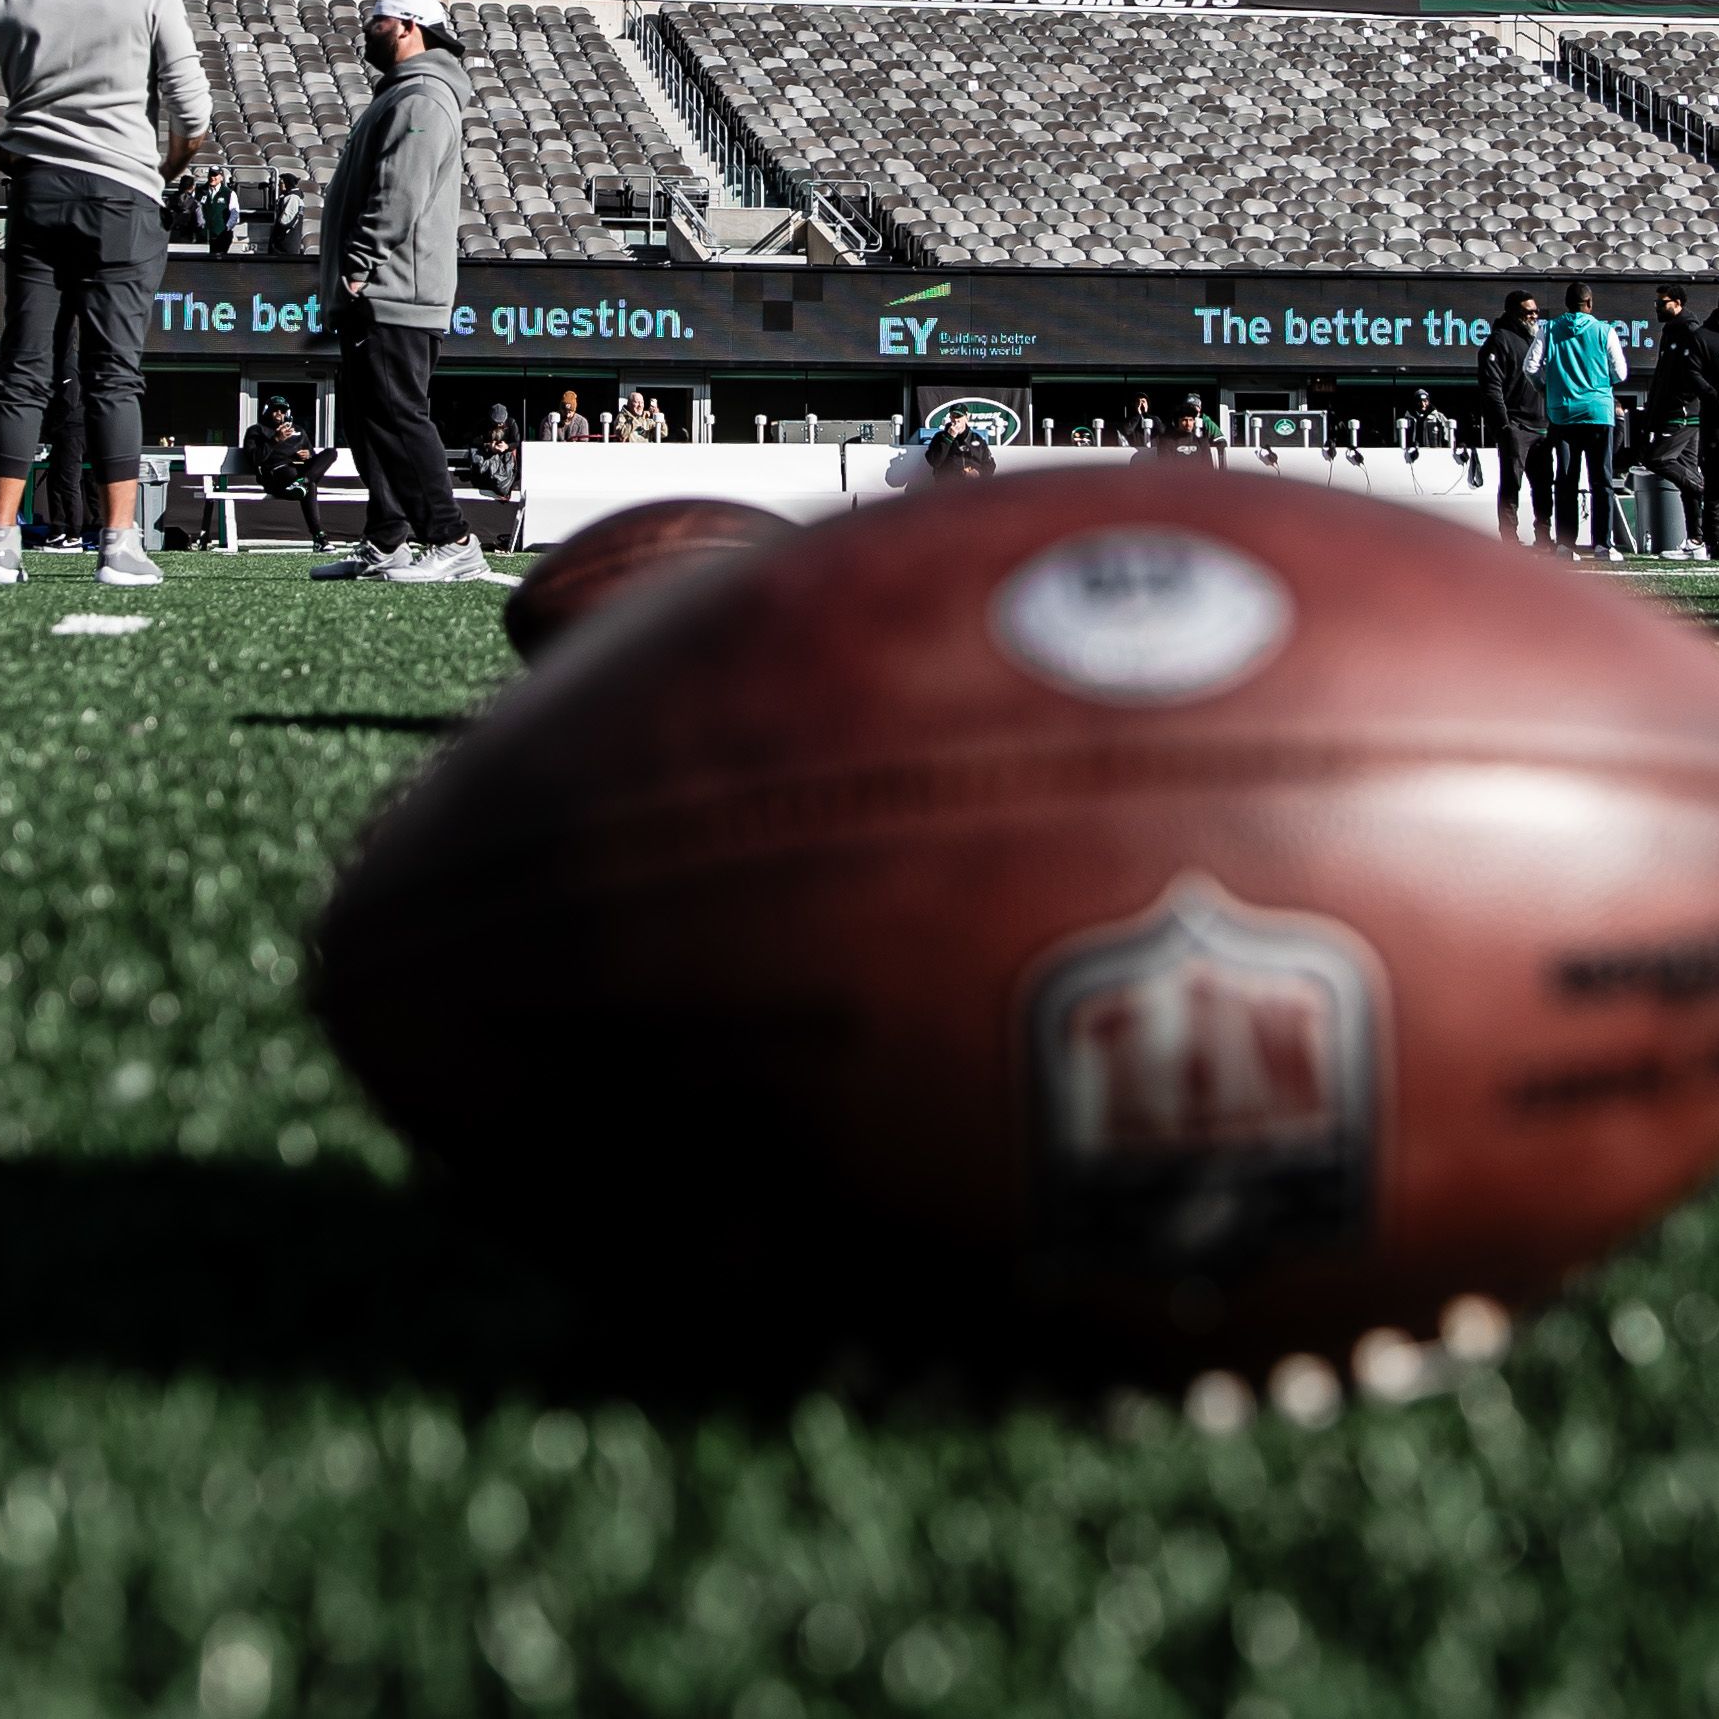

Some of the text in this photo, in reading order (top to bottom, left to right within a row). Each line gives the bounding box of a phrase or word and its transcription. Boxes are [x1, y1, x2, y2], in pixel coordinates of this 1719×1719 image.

[154, 291, 323, 333] The bet
[491, 298, 695, 346] question.
[1194, 306, 1492, 347] The better the
[879, 317, 939, 355] EY
[938, 331, 1038, 346] Building a better
[938, 345, 1023, 358] working world
